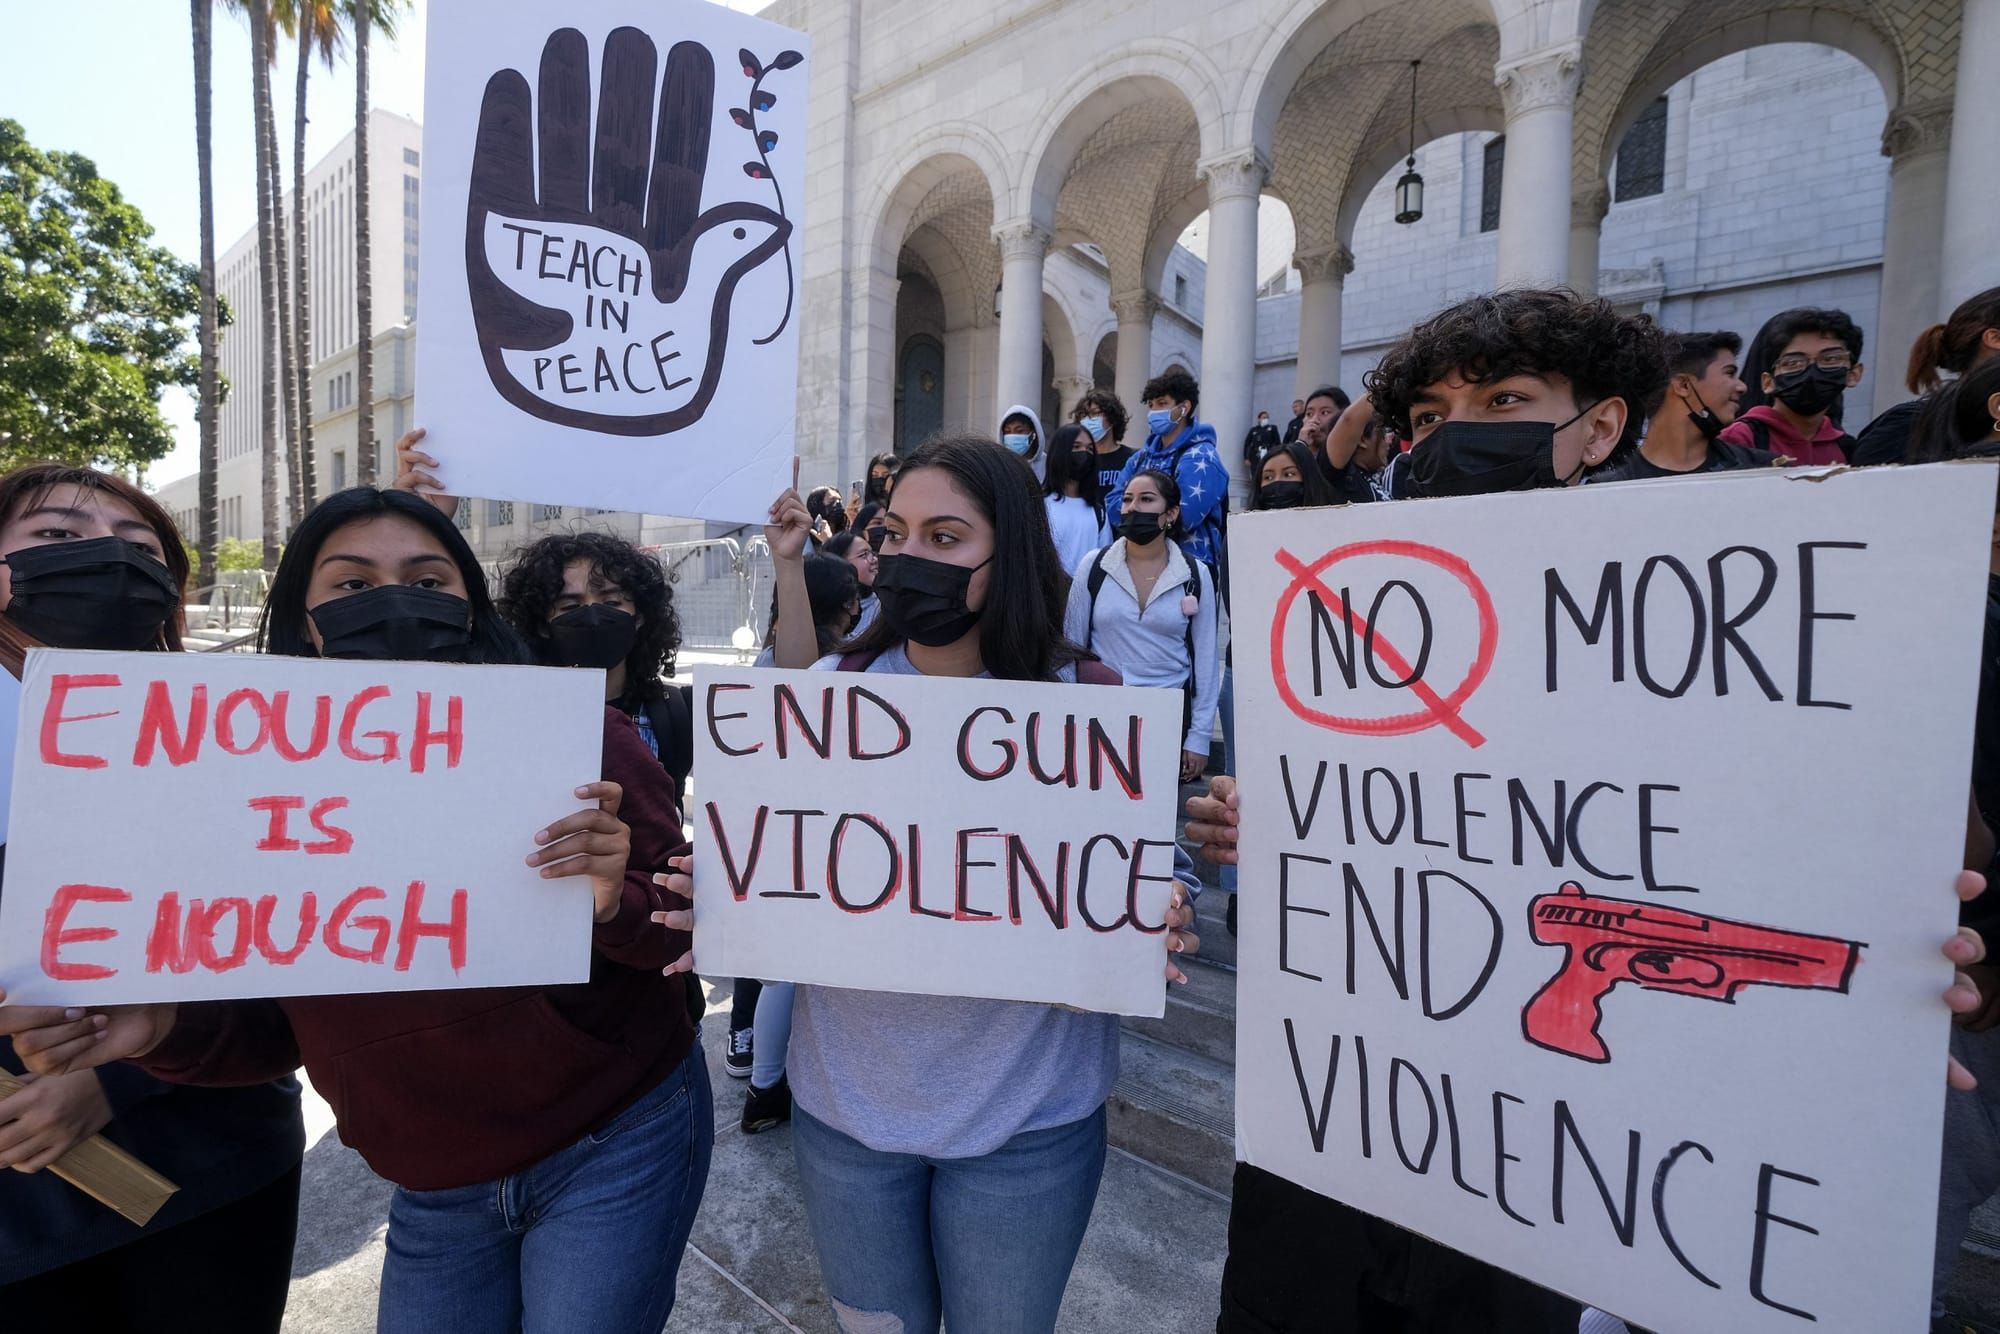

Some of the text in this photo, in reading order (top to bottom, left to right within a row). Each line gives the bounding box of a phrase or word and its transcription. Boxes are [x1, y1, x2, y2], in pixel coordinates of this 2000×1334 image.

[503, 223, 643, 297] TEACH
[586, 294, 629, 334] IN
[534, 330, 693, 393] PEACE
[1308, 541, 1868, 711] NO MORE
[40, 673, 464, 774] ENOUGH
[706, 684, 1144, 801] END GUN
[247, 796, 355, 855] IS
[705, 801, 1176, 935] VIOLENCE
[1279, 754, 1700, 893] VIOLENCE
[40, 880, 468, 981] ENOUGH
[1279, 852, 1505, 1022] END
[1283, 1017, 1822, 1323] VIOLENCE
